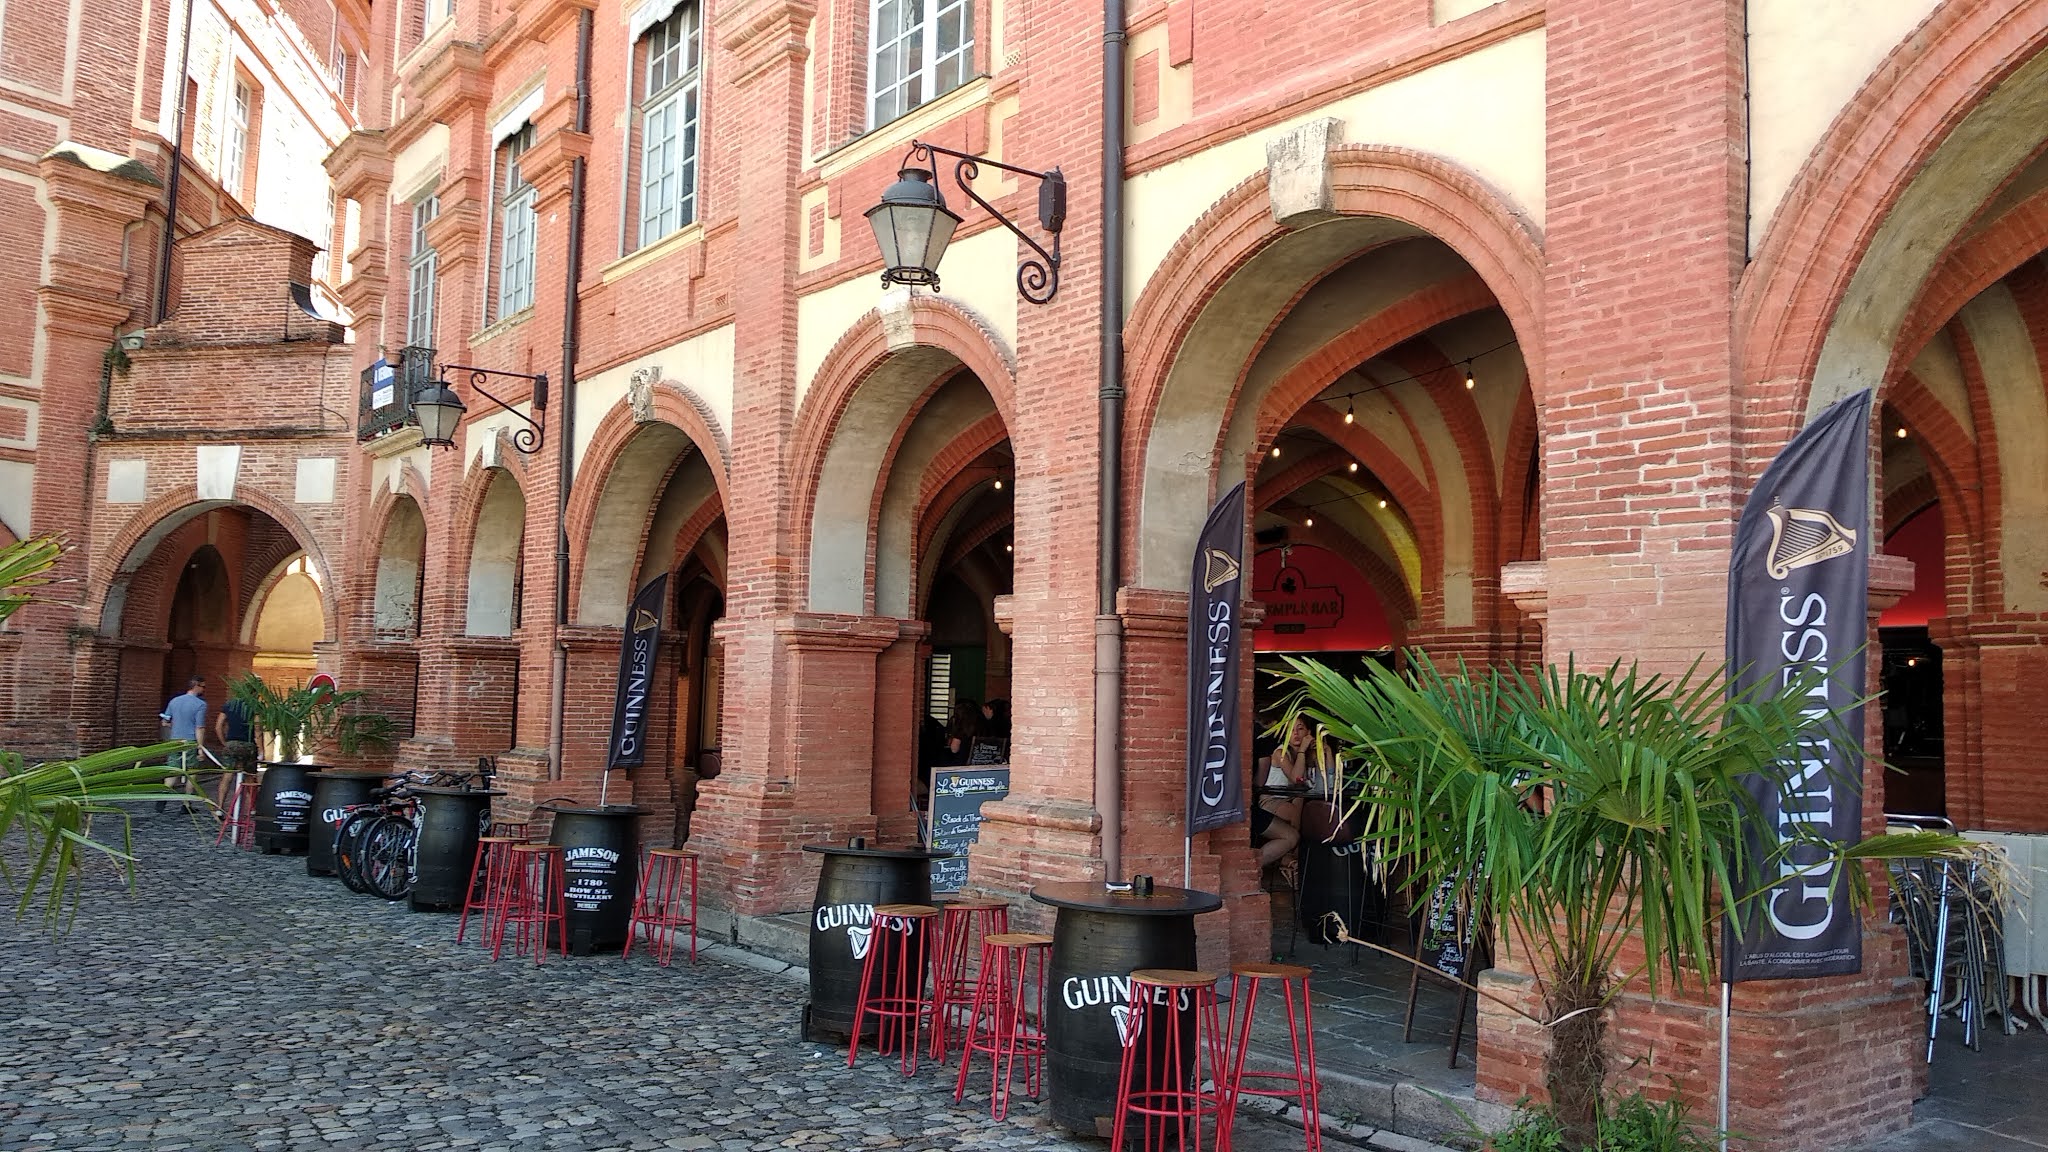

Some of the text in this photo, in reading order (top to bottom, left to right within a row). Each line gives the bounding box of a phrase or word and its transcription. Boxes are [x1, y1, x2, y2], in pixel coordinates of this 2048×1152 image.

[1265, 600, 1339, 617] EMPLE BAR
[620, 637, 648, 756] GUINNESS
[1202, 599, 1232, 807] GUINNESS
[959, 777, 996, 788] GUINNESS
[274, 790, 313, 802] JAMESON
[565, 847, 620, 864] JAMESON
[577, 878, 603, 887] 1780
[563, 892, 614, 900] DISTILLERY
[569, 886, 592, 894] BOW
[1792, 950, 1805, 958] EST
[1062, 975, 1192, 1012] GUINES
